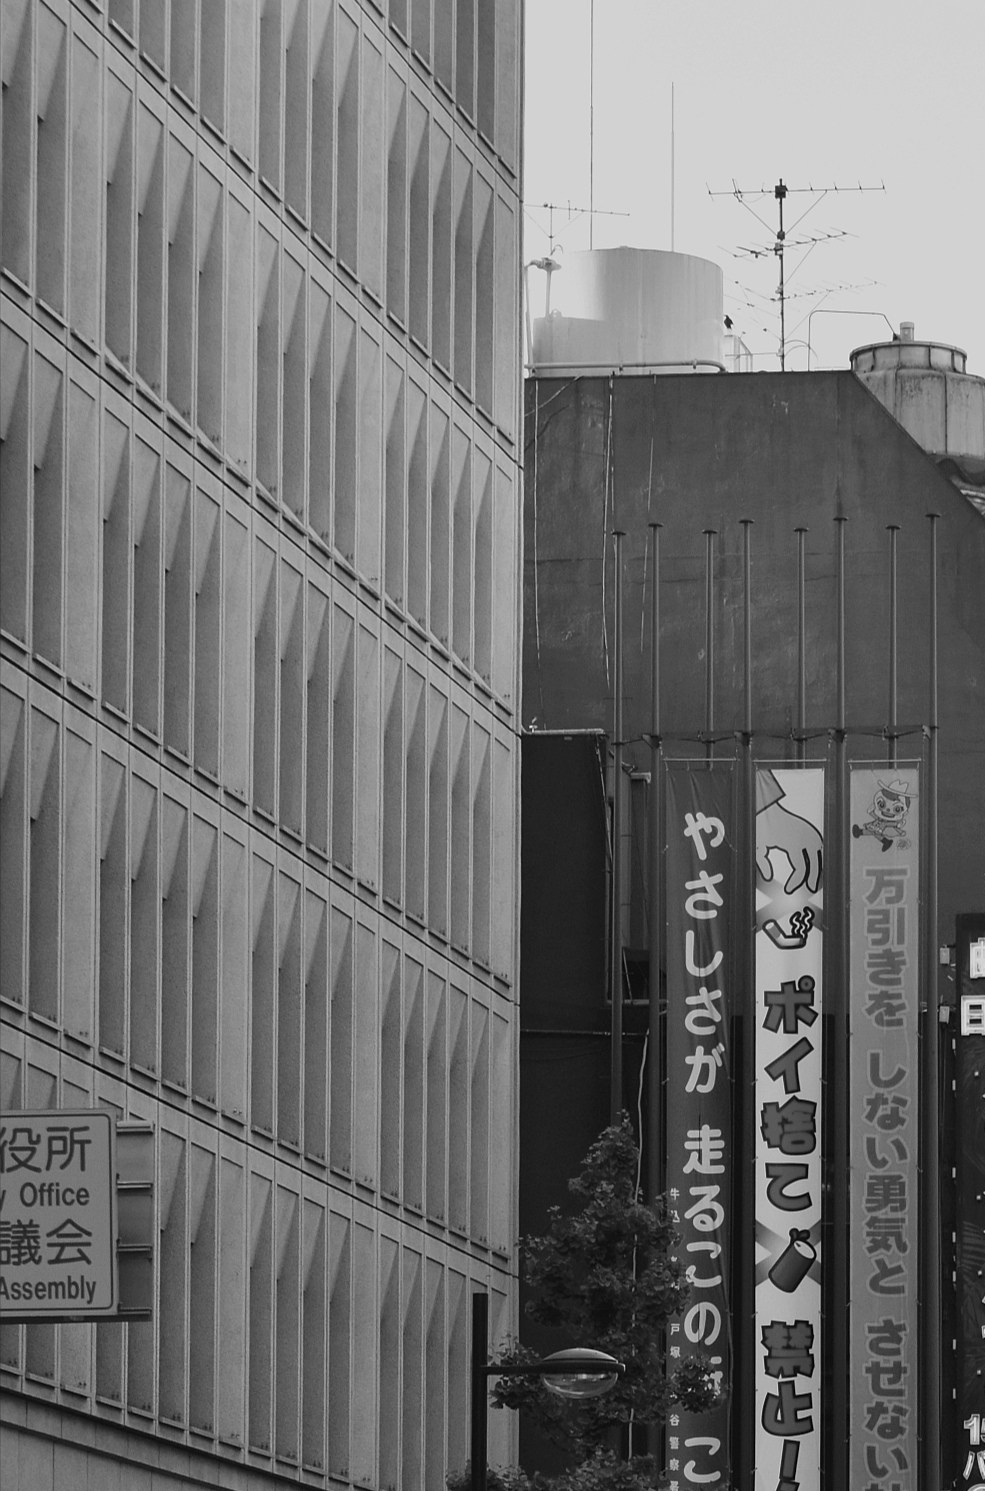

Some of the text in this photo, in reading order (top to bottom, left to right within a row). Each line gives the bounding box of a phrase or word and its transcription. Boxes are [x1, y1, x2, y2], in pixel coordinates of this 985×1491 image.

[684, 812, 725, 1093] やさしさが
[862, 865, 909, 1030] 万引きを
[761, 975, 819, 1212] ポイ捨て
[0, 1275, 96, 1304] Assembly
[20, 1182, 90, 1207] Office
[684, 1124, 725, 1396] 走るこの
